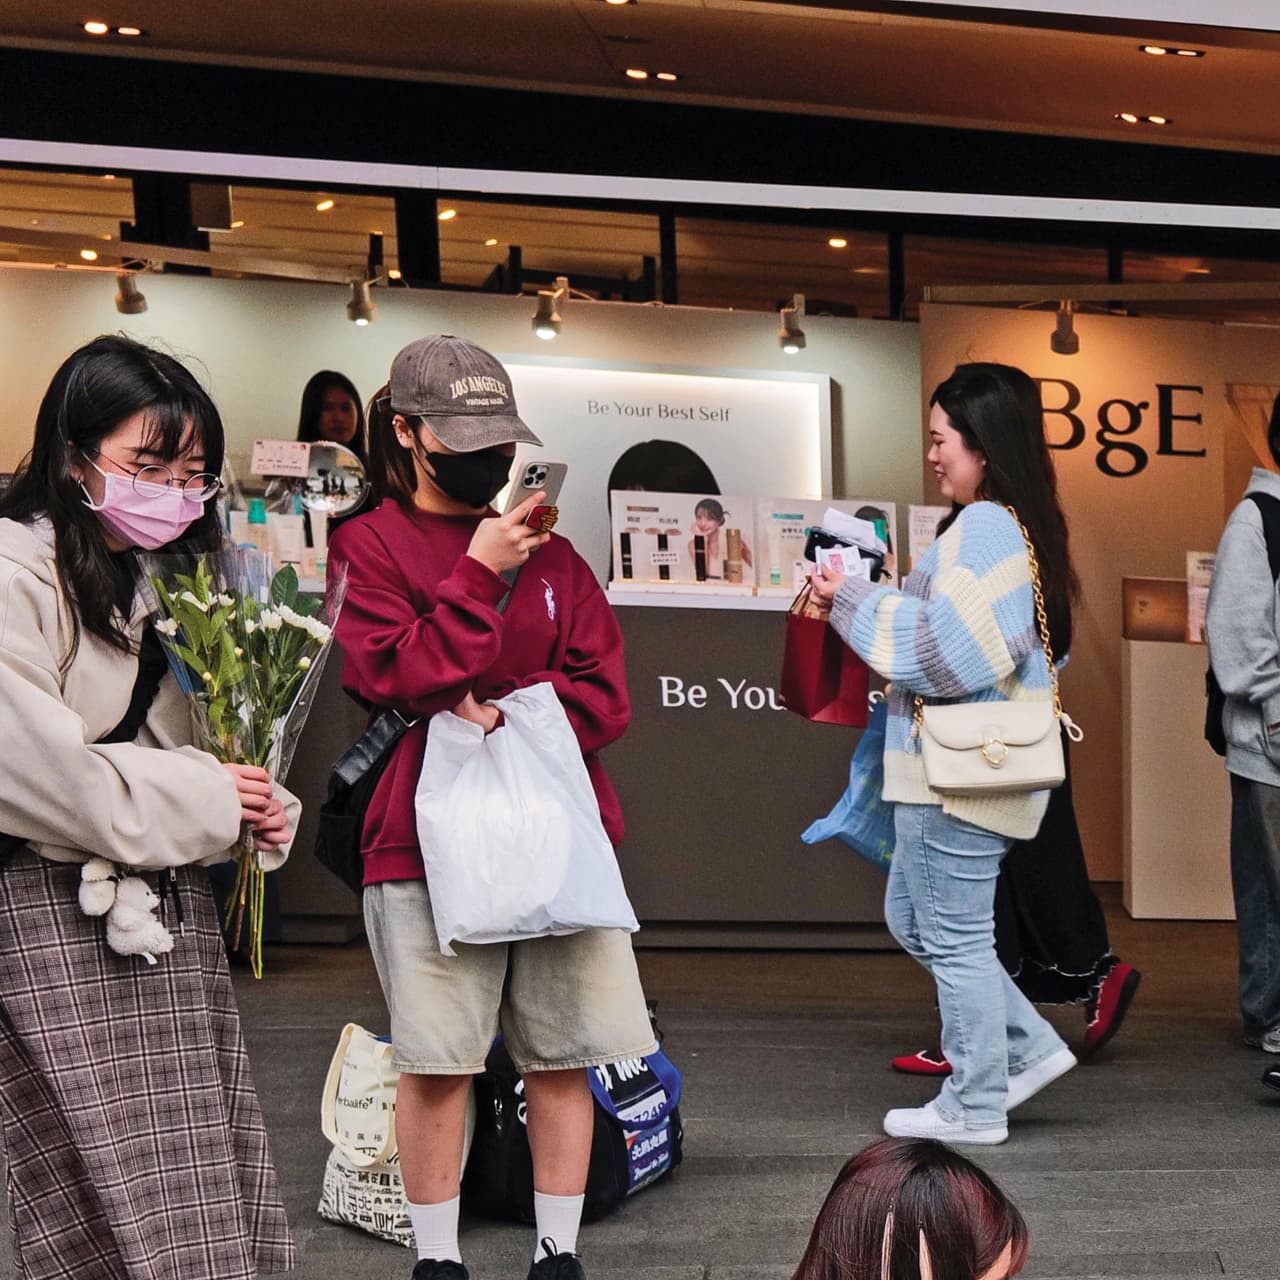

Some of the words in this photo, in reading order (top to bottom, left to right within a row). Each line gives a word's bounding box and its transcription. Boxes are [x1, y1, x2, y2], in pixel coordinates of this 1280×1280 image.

[449, 378, 469, 399] LOS
[588, 399, 610, 416] Be
[613, 401, 653, 418] Your
[657, 403, 695, 420] Best
[698, 406, 732, 422] Self
[658, 675, 708, 709] Be
[717, 678, 788, 711] You
